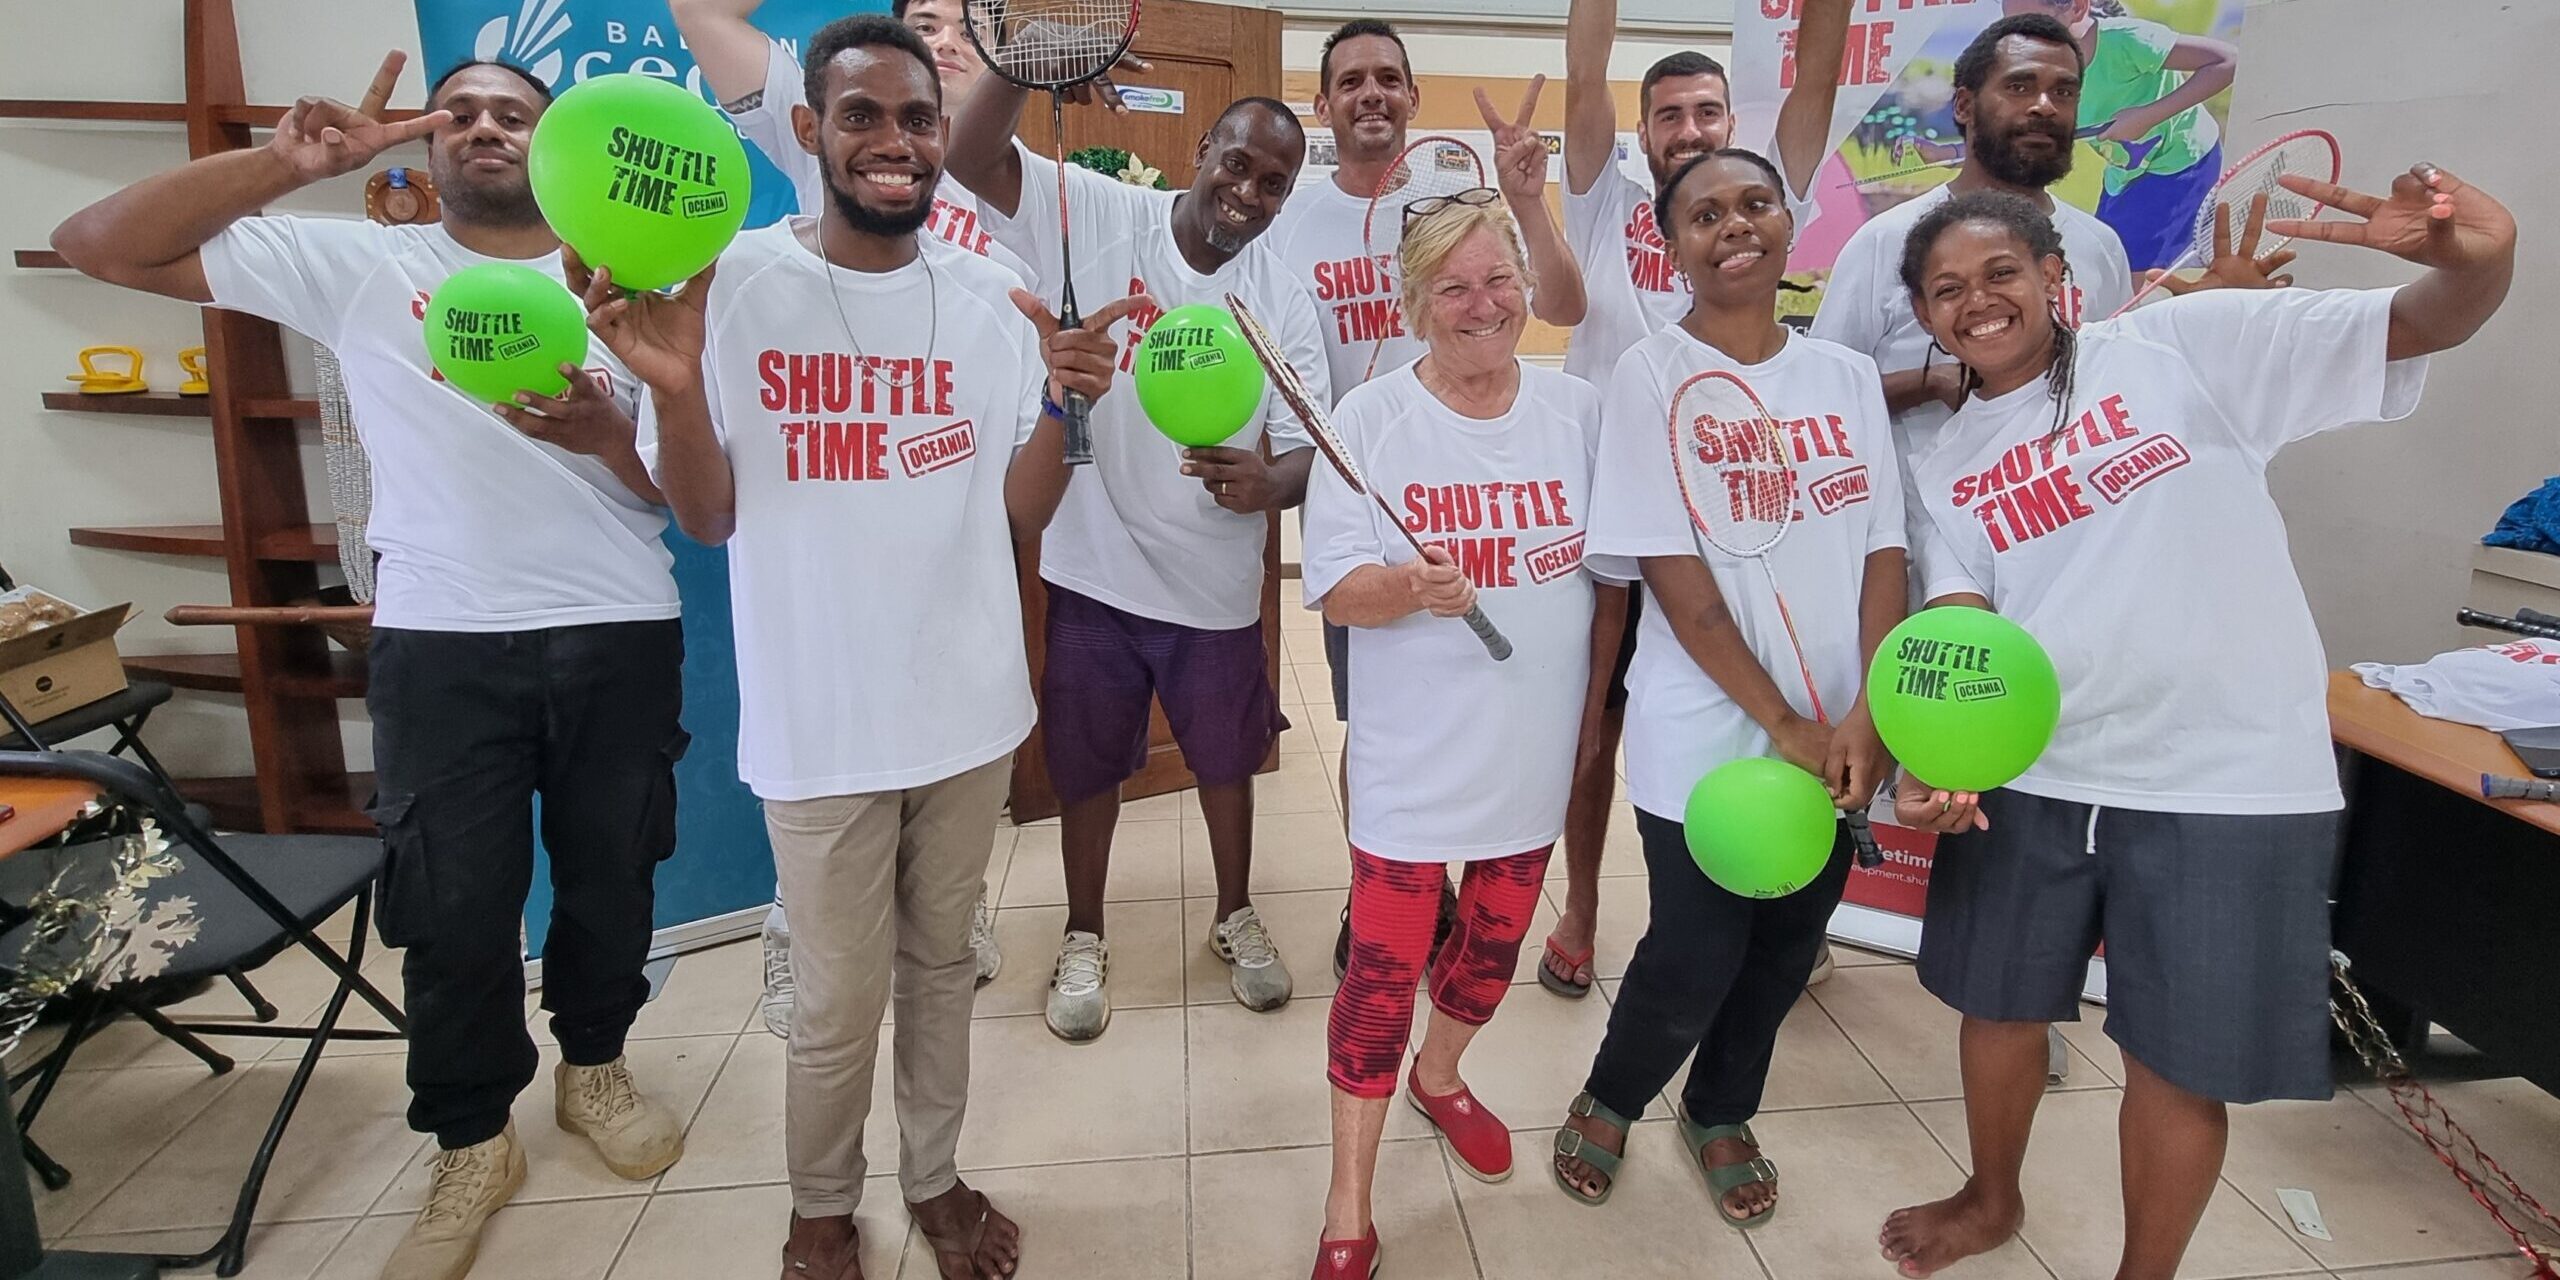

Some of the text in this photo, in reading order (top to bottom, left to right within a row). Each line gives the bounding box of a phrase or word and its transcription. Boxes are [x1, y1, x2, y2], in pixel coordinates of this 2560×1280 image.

[1776, 21, 1895, 89] TME
[607, 126, 717, 187] SHUTTLE
[608, 165, 725, 216] TIME OCEANIA
[927, 199, 993, 255] TTLE
[1313, 254, 1393, 301] SHUT
[445, 307, 523, 336] SHUTTLE
[449, 334, 537, 362] TIME OCEANIA
[1149, 327, 1215, 350] SHUTTLE
[758, 349, 954, 416] SHUTTLE
[1151, 349, 1186, 374] TIME
[1193, 352, 1223, 367] OCEANIA
[779, 420, 972, 482] TIME OCEANIA
[1693, 414, 1855, 466] SHUTTLE
[1951, 393, 2140, 508] SHUTTLE
[1404, 480, 1574, 534] SHUTTLE
[1720, 469, 1805, 523] TIME
[1973, 441, 2179, 553] TIME OCEANIA
[1422, 536, 1518, 589] IME
[1896, 636, 1991, 674] SHUTTLE
[1896, 665, 2002, 701] TIME OCEANIA
